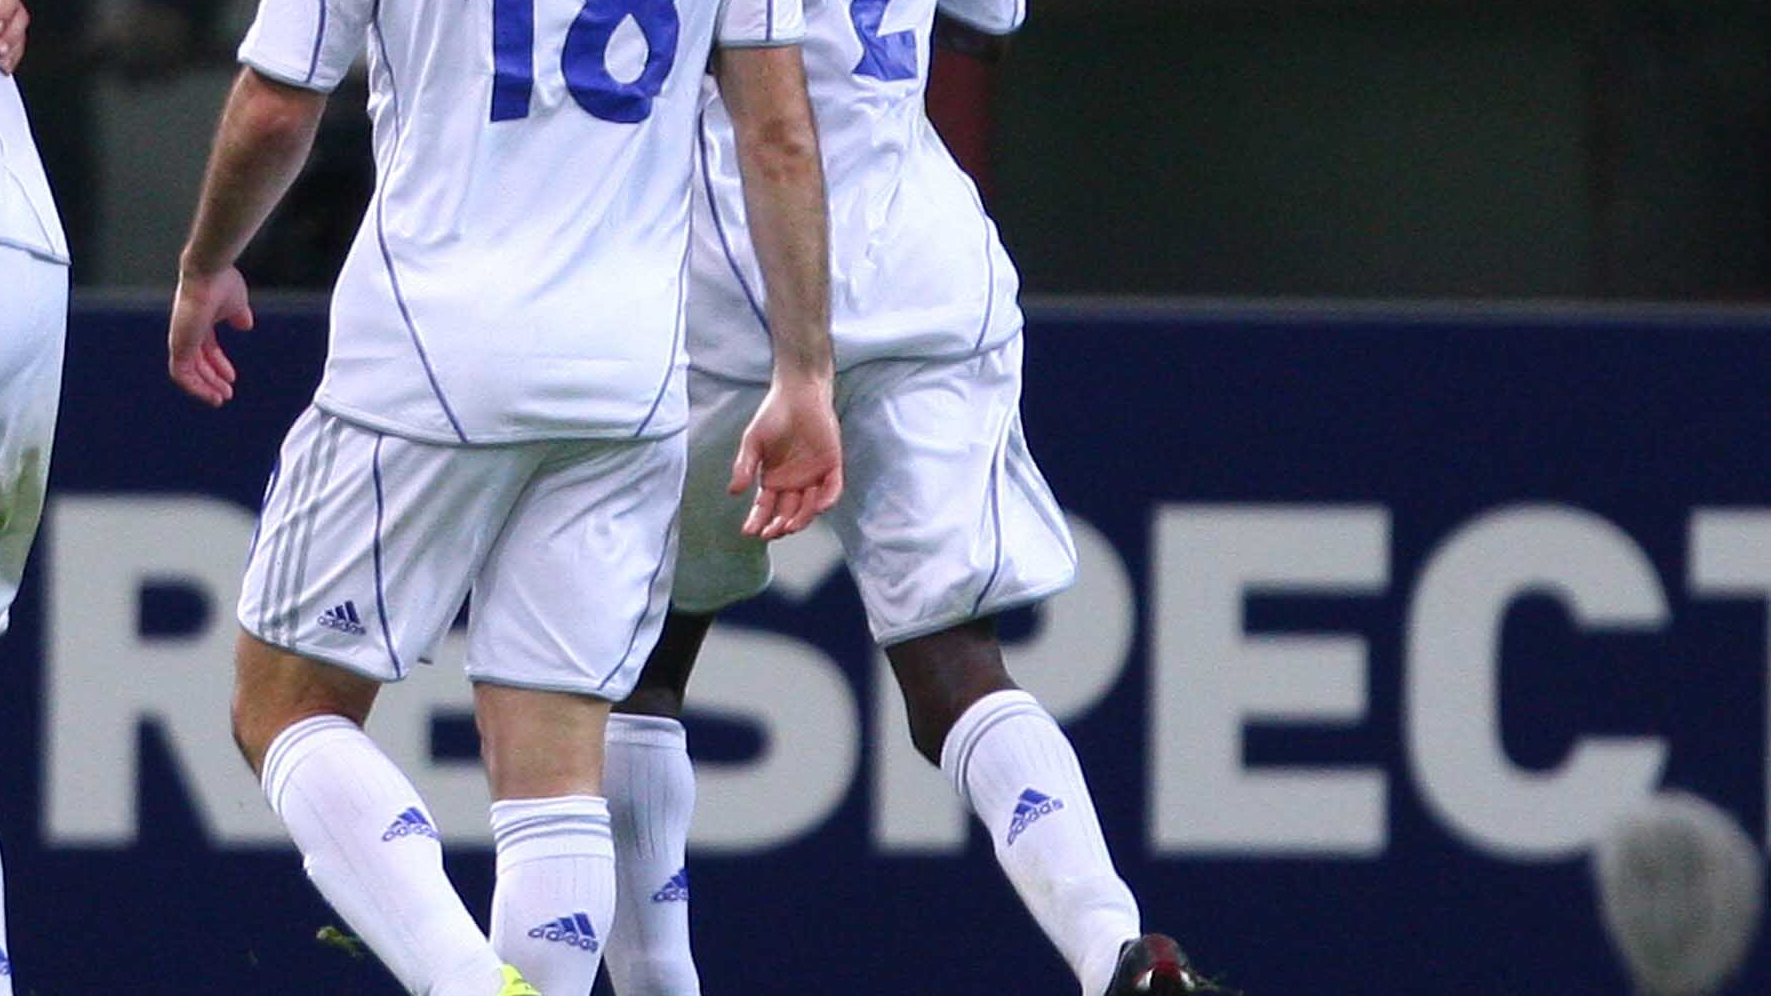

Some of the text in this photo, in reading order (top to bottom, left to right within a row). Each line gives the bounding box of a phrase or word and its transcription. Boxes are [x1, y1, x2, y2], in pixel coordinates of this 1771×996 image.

[317, 615, 367, 636] adidas
[1007, 797, 1065, 846] adidas
[527, 926, 599, 954] adidas
